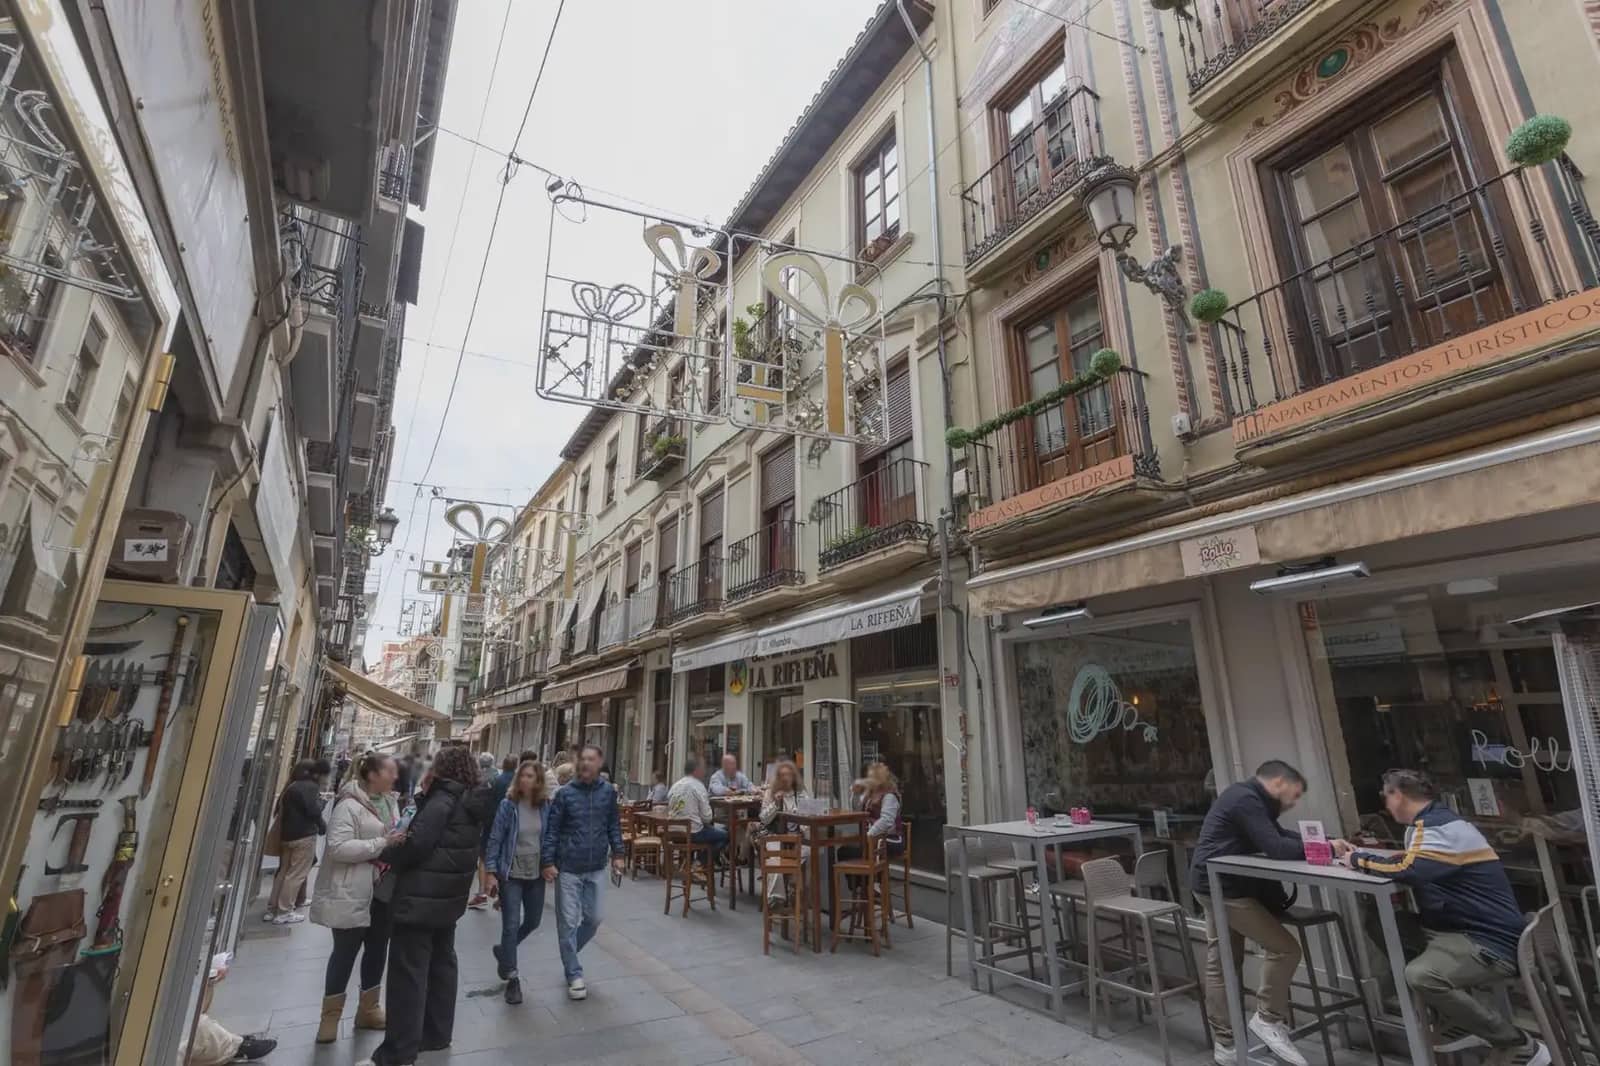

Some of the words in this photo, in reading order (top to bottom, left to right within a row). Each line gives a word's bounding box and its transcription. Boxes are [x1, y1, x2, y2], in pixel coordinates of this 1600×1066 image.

[1266, 360, 1434, 427] APARTAMENTOS
[985, 499, 1024, 523] CASA
[1039, 461, 1128, 503] CATEDRAL
[1200, 543, 1234, 562] ROLLO
[850, 618, 863, 630] LA
[867, 604, 912, 628] RIFFEÑA
[748, 666, 768, 689] LA
[1471, 728, 1575, 773] Roll
